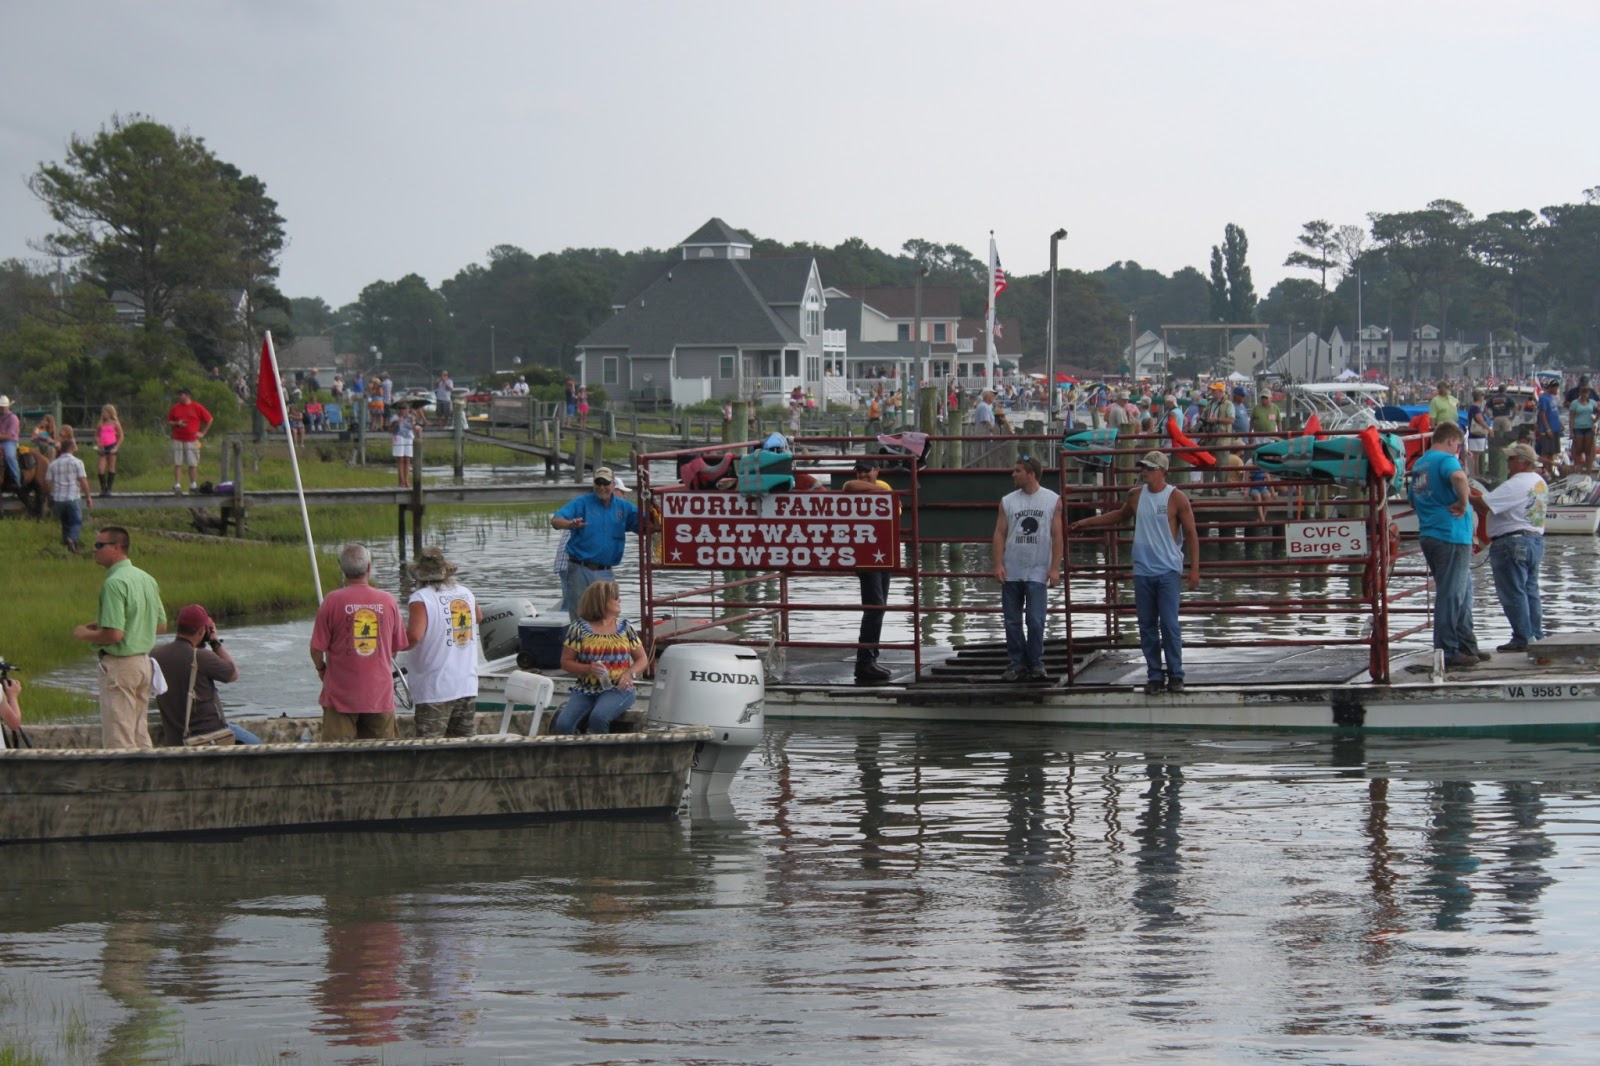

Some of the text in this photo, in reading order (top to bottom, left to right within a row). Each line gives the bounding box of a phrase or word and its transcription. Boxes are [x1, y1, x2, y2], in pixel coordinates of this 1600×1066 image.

[665, 495, 891, 517] WORLD FAMOUS
[675, 523, 878, 544] SALTWATER
[1302, 526, 1351, 539] CVFC
[1290, 538, 1361, 554] Barge 3
[696, 546, 857, 567] COWBOYS
[689, 670, 760, 686] HONDA
[1508, 685, 1579, 698] VA 9583 C
